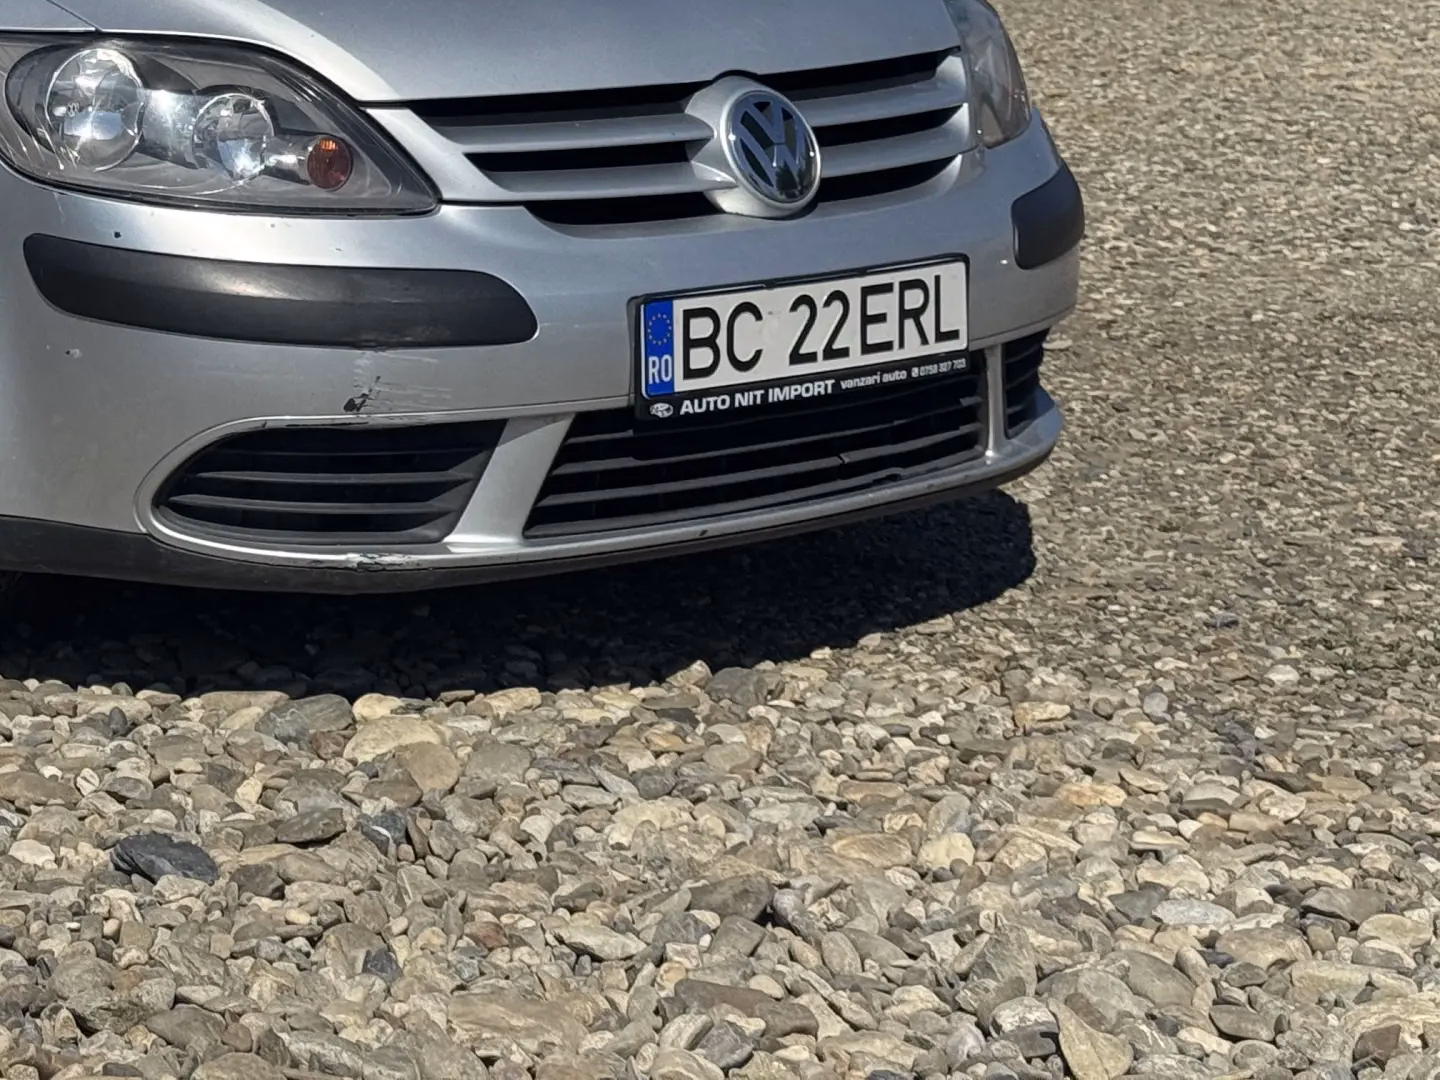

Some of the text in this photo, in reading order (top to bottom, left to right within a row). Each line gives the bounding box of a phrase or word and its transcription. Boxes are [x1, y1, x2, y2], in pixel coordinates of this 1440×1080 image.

[682, 300, 764, 381] BC
[647, 353, 674, 386] RO
[680, 394, 731, 415] AUTO
[734, 390, 765, 408] NIT
[768, 379, 836, 403] IMPORT
[882, 369, 907, 383] auto
